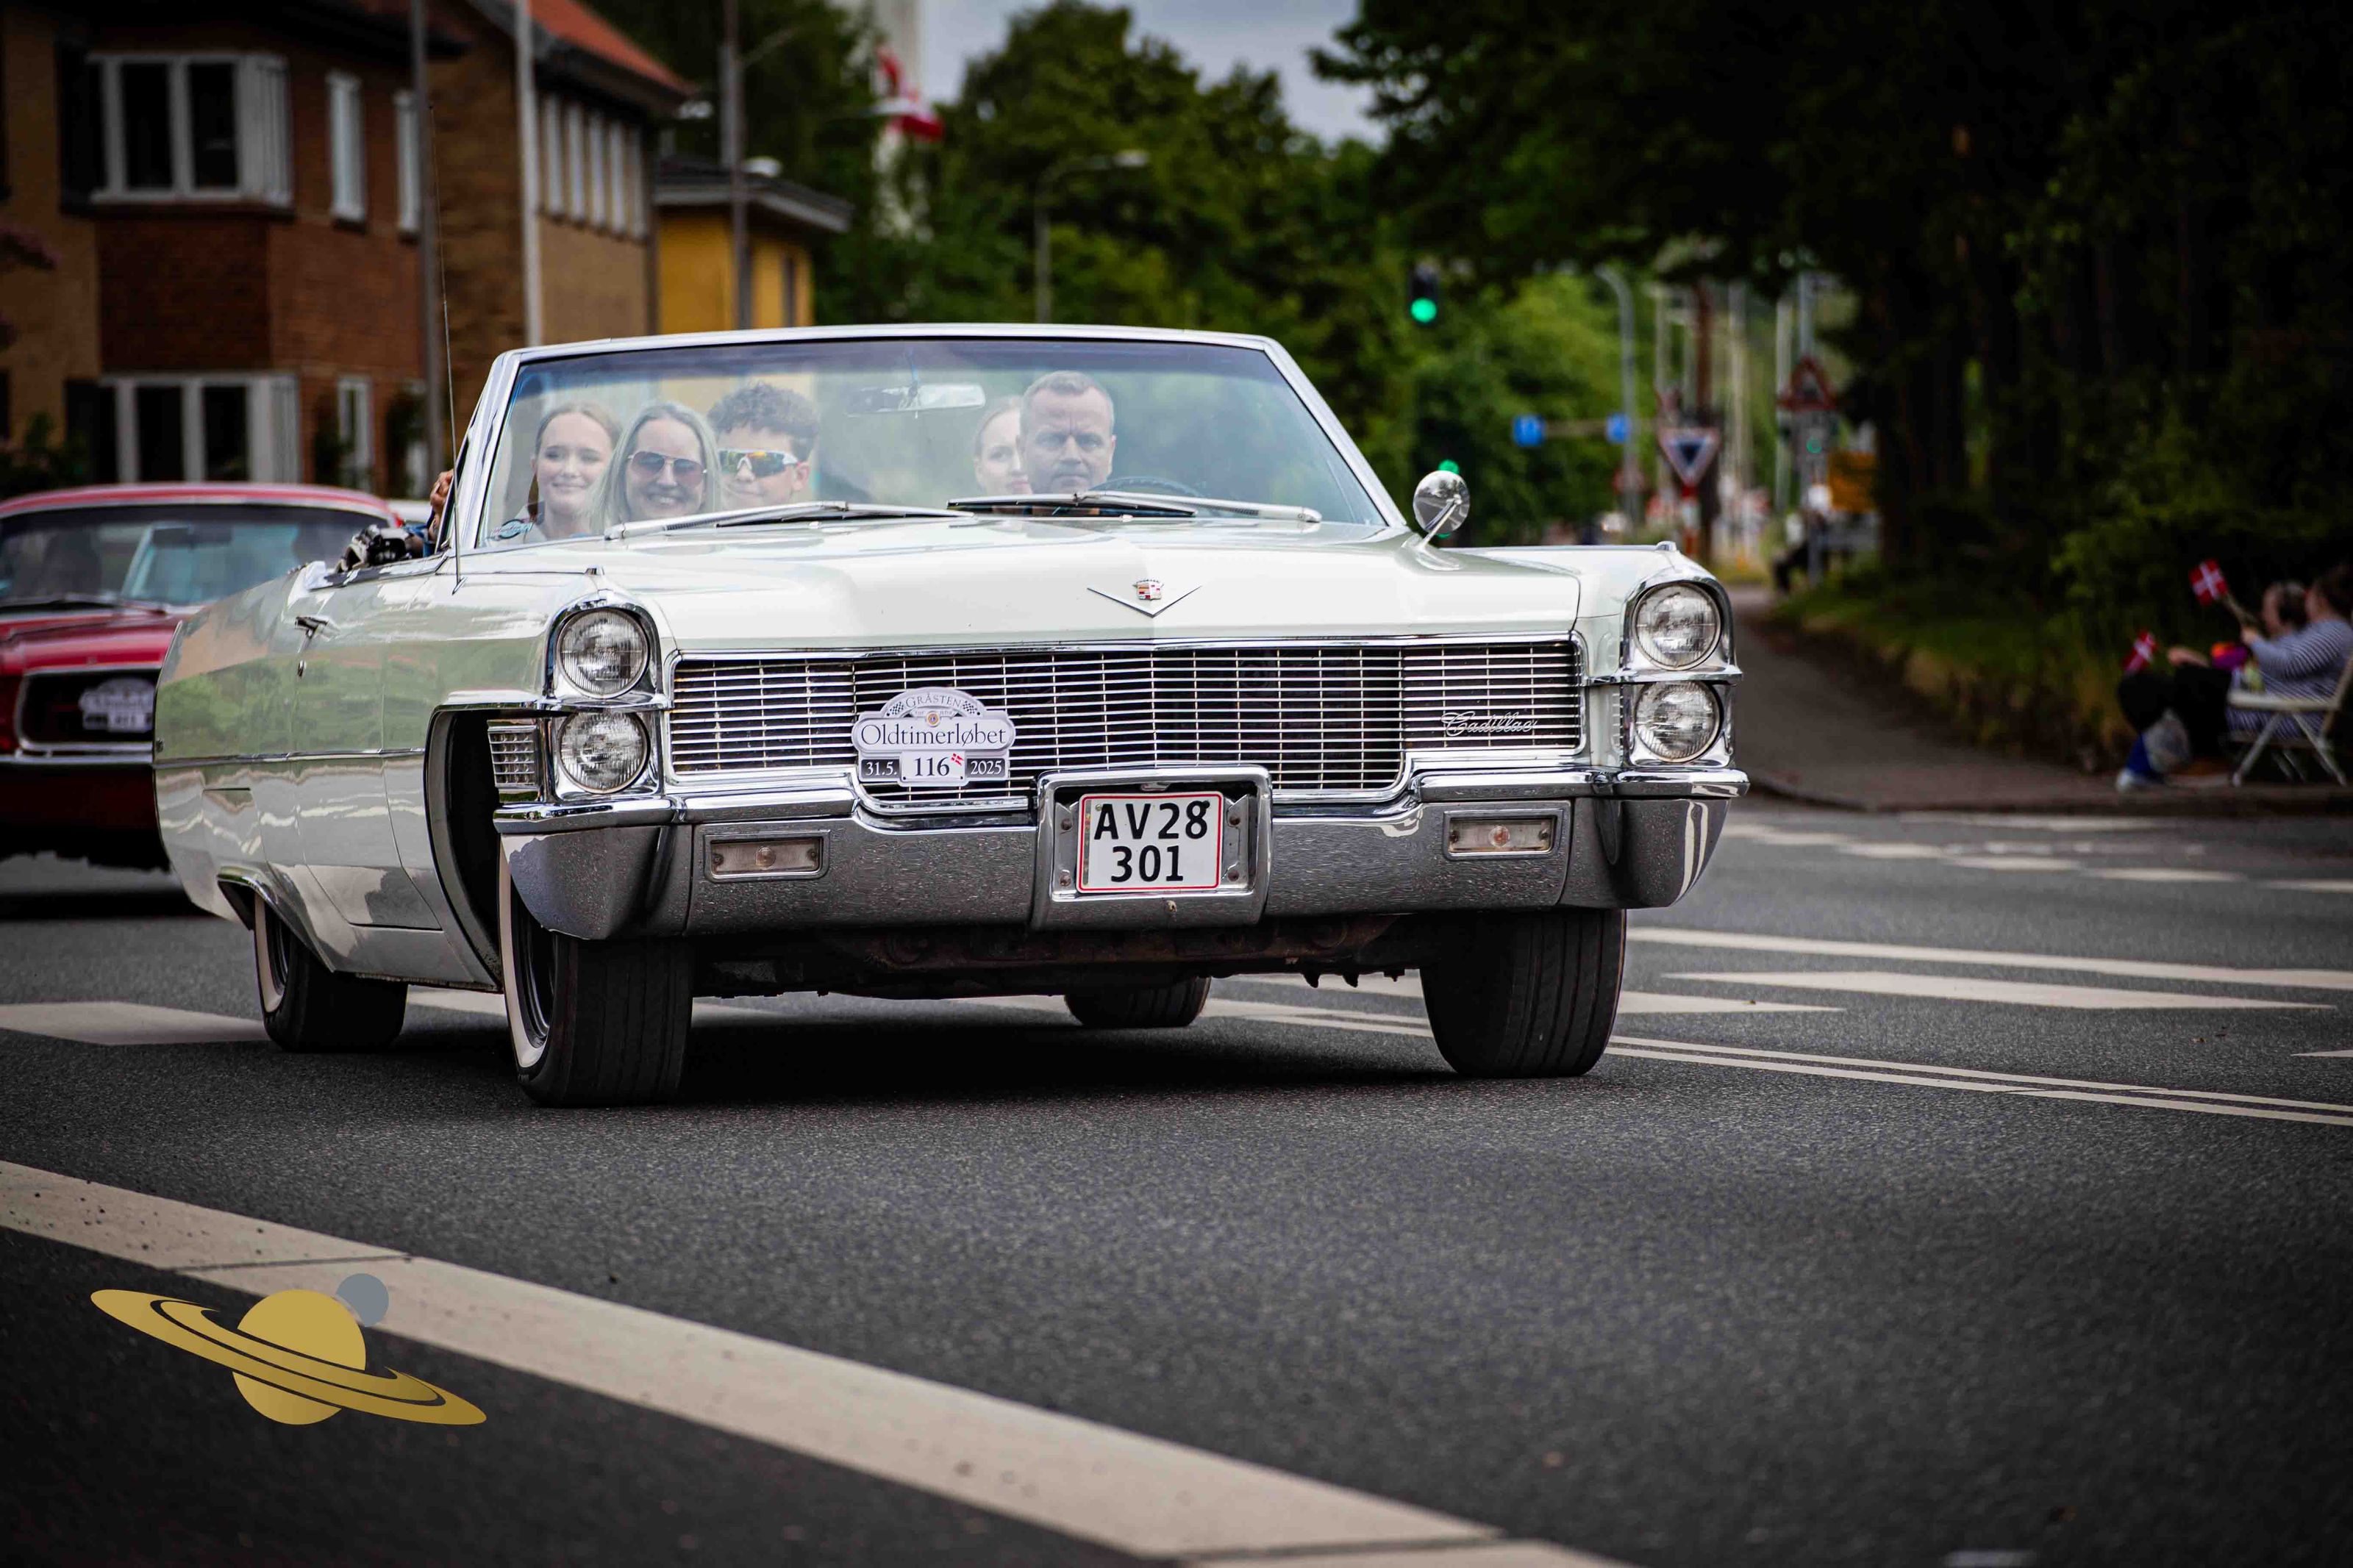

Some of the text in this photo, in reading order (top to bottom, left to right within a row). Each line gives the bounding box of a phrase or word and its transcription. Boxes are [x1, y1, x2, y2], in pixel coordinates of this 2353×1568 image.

[906, 692, 963, 708] GRÅSTEN
[861, 722, 1006, 746] Oldtimerløbet
[1440, 711, 1538, 737] Cadillac
[865, 756, 1002, 777] 31.5. 116 2025
[1110, 845, 1184, 882] 301
